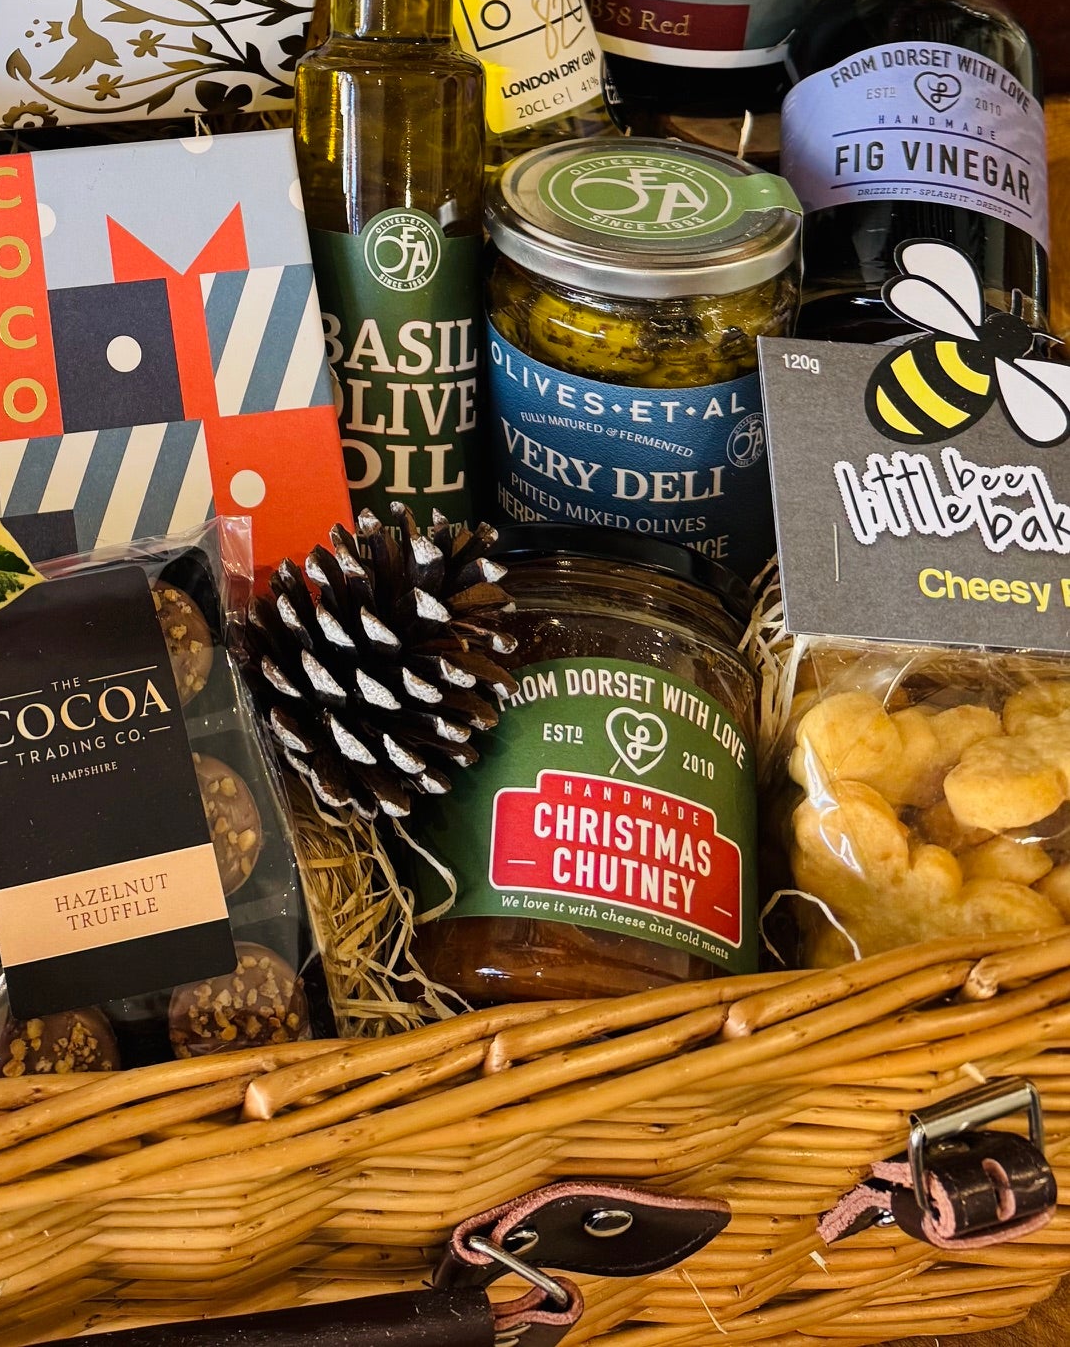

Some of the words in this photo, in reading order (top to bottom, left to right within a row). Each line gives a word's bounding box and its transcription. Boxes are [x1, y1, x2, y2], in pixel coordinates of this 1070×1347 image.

[639, 9, 690, 37] Red
[501, 67, 560, 99] LONDON
[559, 59, 581, 78] DRY
[581, 49, 596, 67] GIN
[830, 55, 876, 88] FROM
[882, 49, 951, 68] DORSET
[957, 54, 996, 84] WITH
[1000, 75, 1029, 113] LOVE
[516, 98, 551, 119] 20CL
[878, 115, 997, 140] HANDMADE
[975, 97, 1001, 117] 2010
[835, 142, 884, 176] FIG
[901, 141, 1031, 205] VINEGAR
[857, 187, 899, 197] DRIZZLE
[919, 189, 957, 201] SPLASH
[589, 214, 646, 231] SINCE
[378, 273, 403, 289] SINCE
[782, 353, 820, 374] 120g
[520, 411, 546, 427] FULLY
[548, 415, 603, 435] MATURED
[620, 429, 693, 458] FERMENTED
[340, 439, 464, 493] OIL
[501, 417, 605, 492] VERY
[613, 466, 725, 503] DELI
[949, 454, 1024, 491] bee
[511, 472, 561, 511] PITTED
[566, 505, 630, 530] MIXED
[635, 516, 706, 535] OLIVES
[842, 458, 972, 537] little
[918, 568, 1051, 613] Cheesy
[50, 676, 82, 691] THE
[565, 669, 654, 704] DORSET
[663, 682, 708, 730] WITH
[712, 713, 747, 770] LOVE
[15, 735, 107, 767] TRADING
[115, 728, 146, 746] CO.
[682, 751, 714, 780] 2010
[51, 761, 118, 784] HAMPSHIRE
[564, 781, 699, 827] HANDMADE
[533, 802, 711, 877] CHRISTMAS
[54, 872, 169, 913] HAZELNUT
[552, 848, 696, 914] CHUTNEY
[66, 897, 159, 932] TRUFFLE
[501, 894, 519, 908] We
[523, 895, 549, 911] love
[554, 899, 564, 913] it
[568, 902, 598, 919] with
[601, 910, 645, 929] cheese
[649, 920, 672, 938] and
[676, 928, 699, 947] cold
[701, 939, 729, 961] meats
